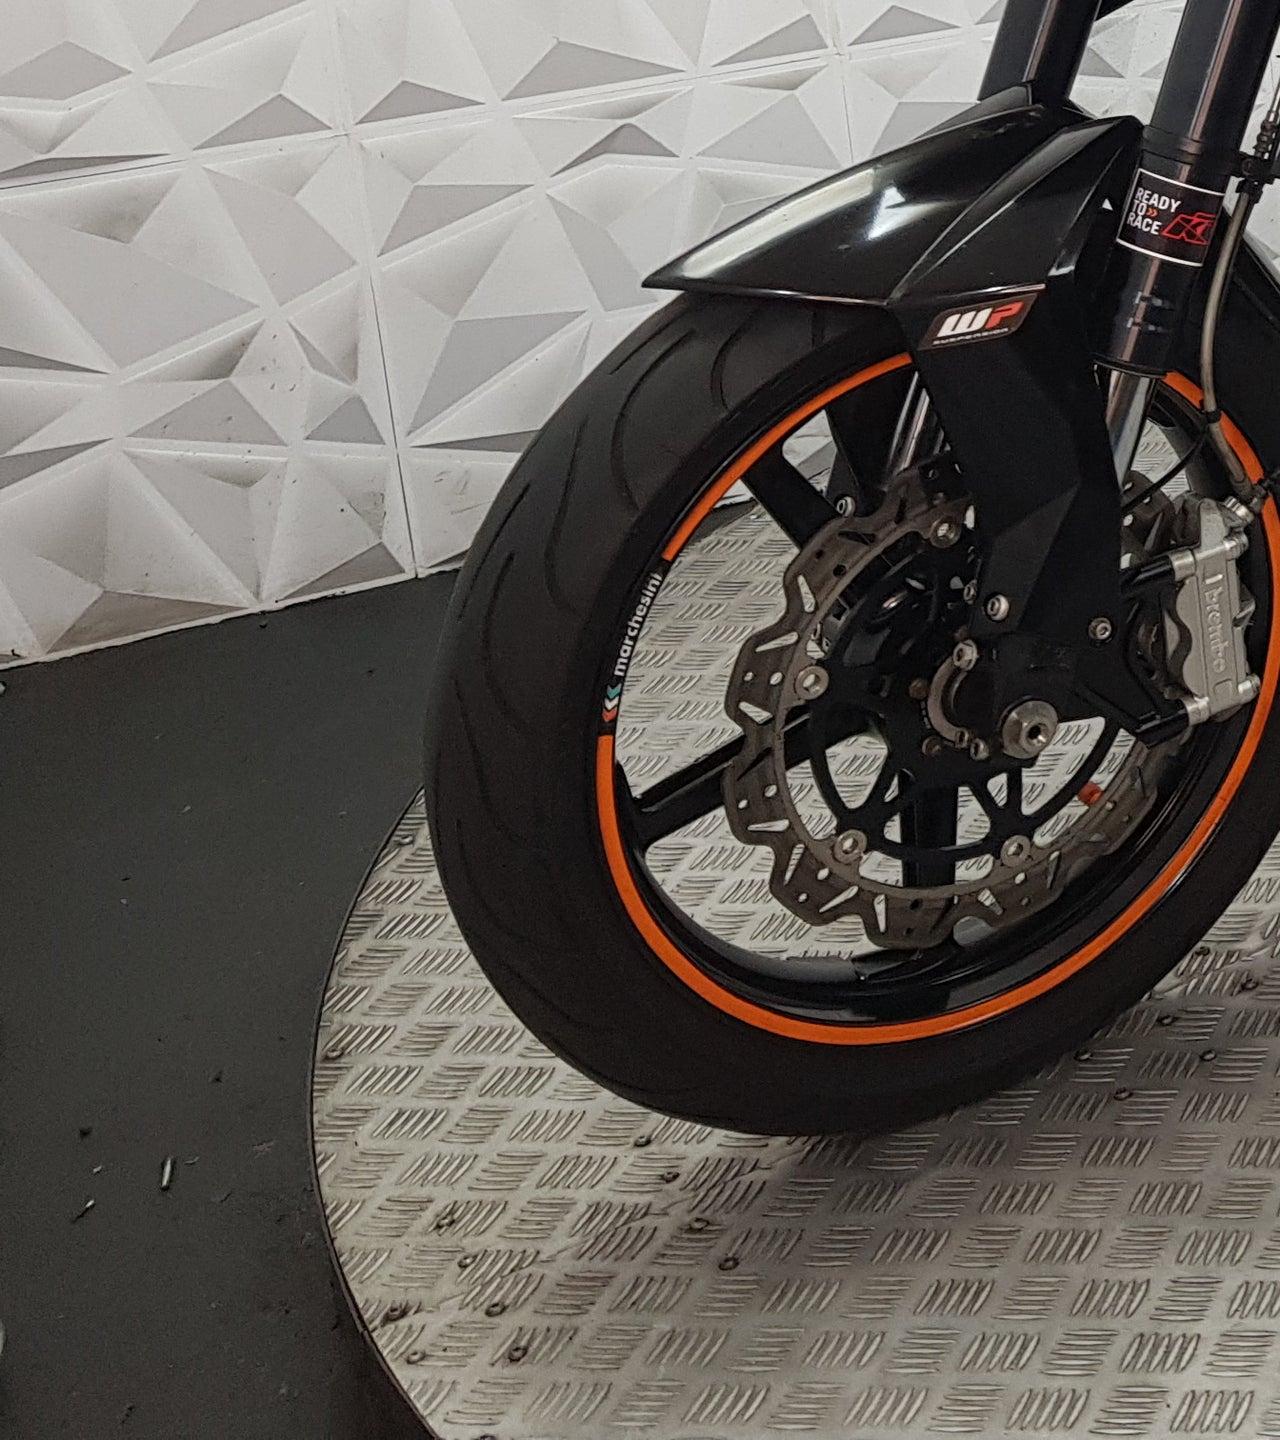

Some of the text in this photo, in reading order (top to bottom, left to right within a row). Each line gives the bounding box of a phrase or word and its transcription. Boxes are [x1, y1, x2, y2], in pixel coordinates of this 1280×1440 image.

[1132, 200, 1147, 216] TO
[1135, 187, 1181, 213] READY
[1127, 212, 1162, 235] RACE
[937, 301, 1024, 337] WP
[614, 572, 663, 677] marchesini
[1204, 586, 1230, 674] brembo
